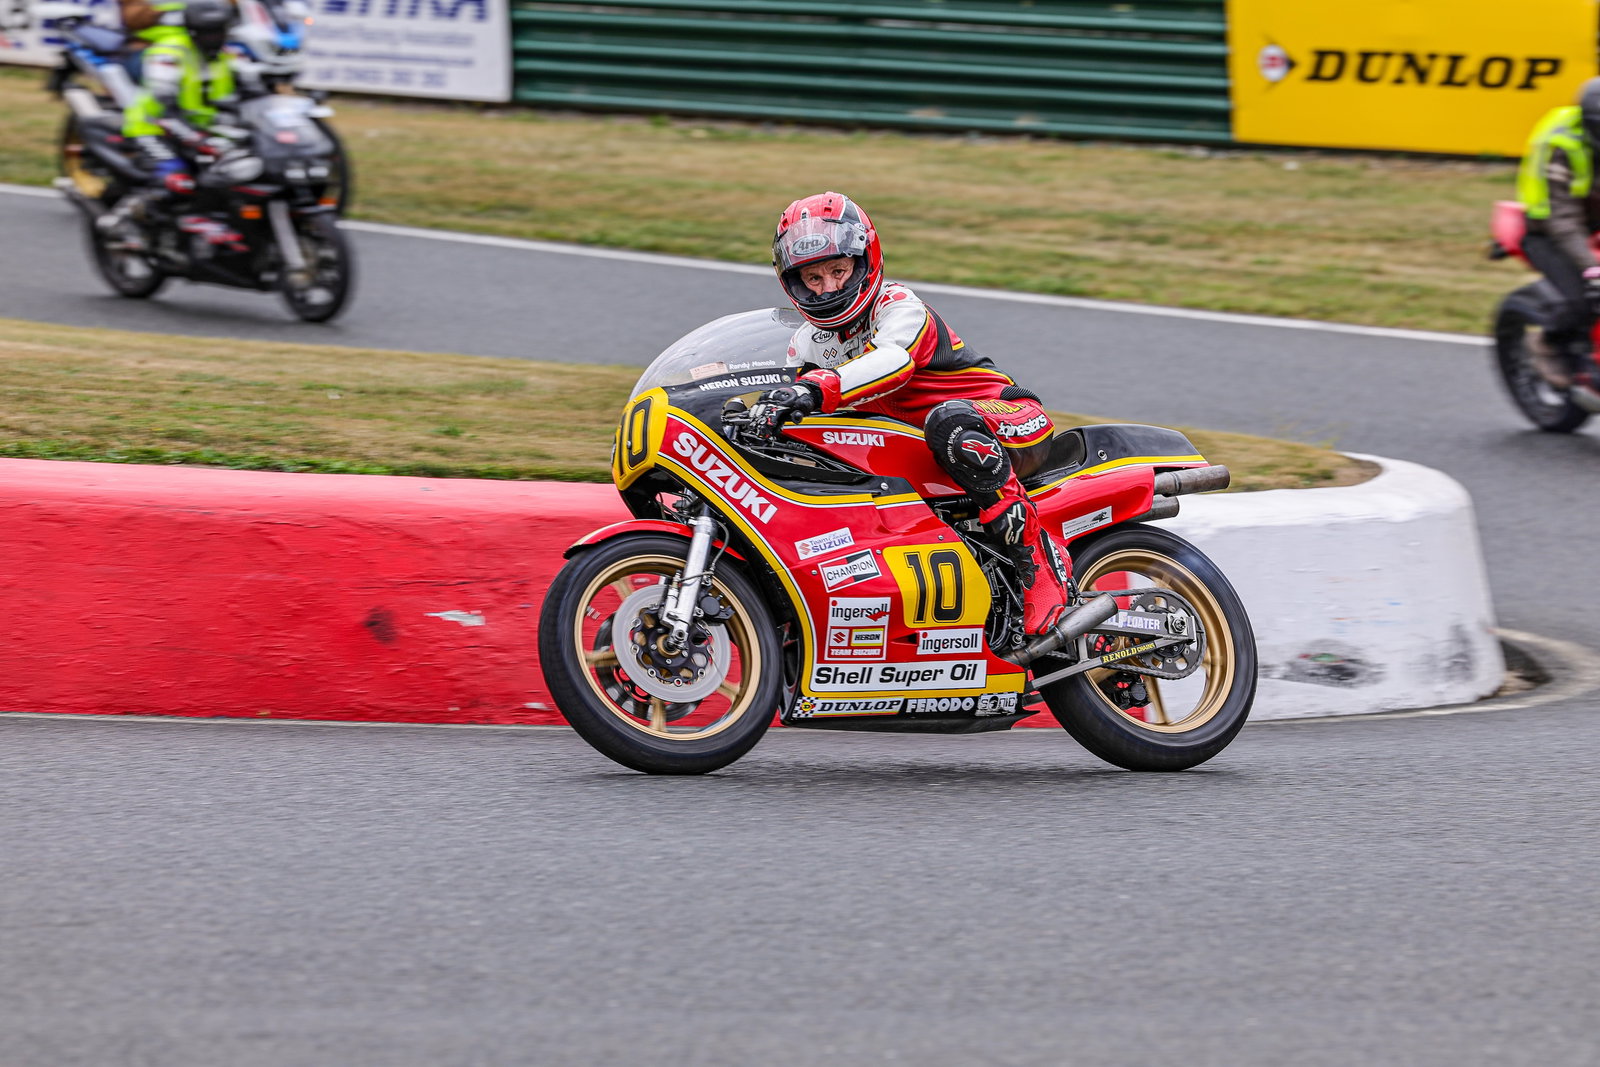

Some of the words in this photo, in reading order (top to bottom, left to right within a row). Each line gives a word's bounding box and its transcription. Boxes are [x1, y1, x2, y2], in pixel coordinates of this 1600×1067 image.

[1302, 49, 1564, 90] DUNLOP
[699, 378, 740, 392] HERON
[740, 373, 782, 386] SUZUKI
[822, 431, 886, 447] SUZUKI
[672, 431, 779, 525] SUZUKI
[809, 537, 828, 546] Team
[811, 535, 852, 553] SUZUKI
[826, 559, 874, 581] CHAMPION
[903, 548, 965, 624] 10
[831, 600, 888, 621] ingersoll
[1118, 611, 1160, 630] FLOATER
[854, 633, 881, 641] HERON
[921, 631, 978, 653] ingersoll
[1102, 647, 1137, 663] RENOLD
[815, 666, 873, 685] Shell
[879, 666, 943, 687] Super
[950, 663, 977, 682] Oil
[818, 700, 902, 712] DUNLOP
[905, 697, 975, 713] FERODO
